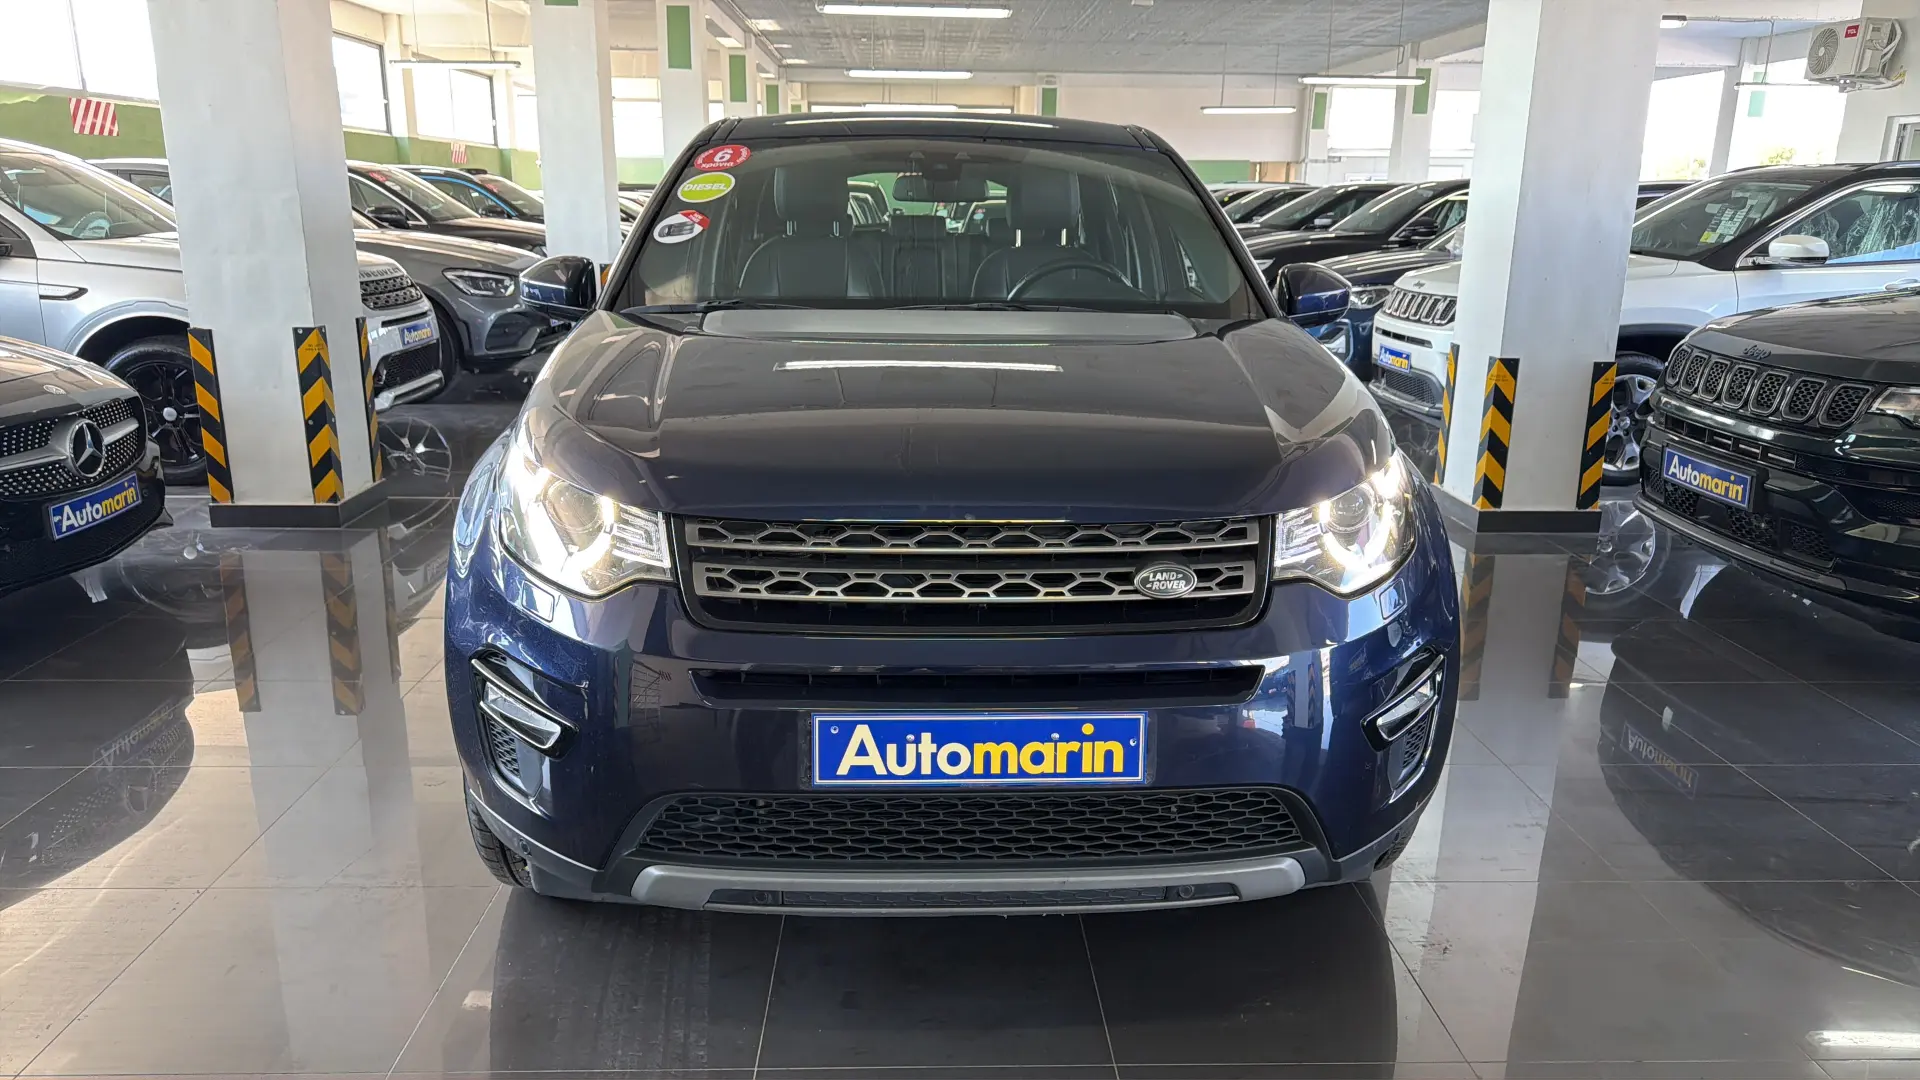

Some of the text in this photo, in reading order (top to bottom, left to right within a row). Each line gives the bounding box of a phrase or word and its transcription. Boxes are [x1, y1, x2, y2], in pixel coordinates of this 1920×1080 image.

[714, 150, 733, 163] 6
[683, 183, 727, 191] DIESEL
[1743, 344, 1772, 360] Jeep
[1668, 454, 1745, 502] Automarin
[61, 481, 137, 533] Automarin
[1149, 572, 1177, 581] LAND
[1152, 580, 1186, 590] ROVER
[836, 723, 1124, 776] Automarin
